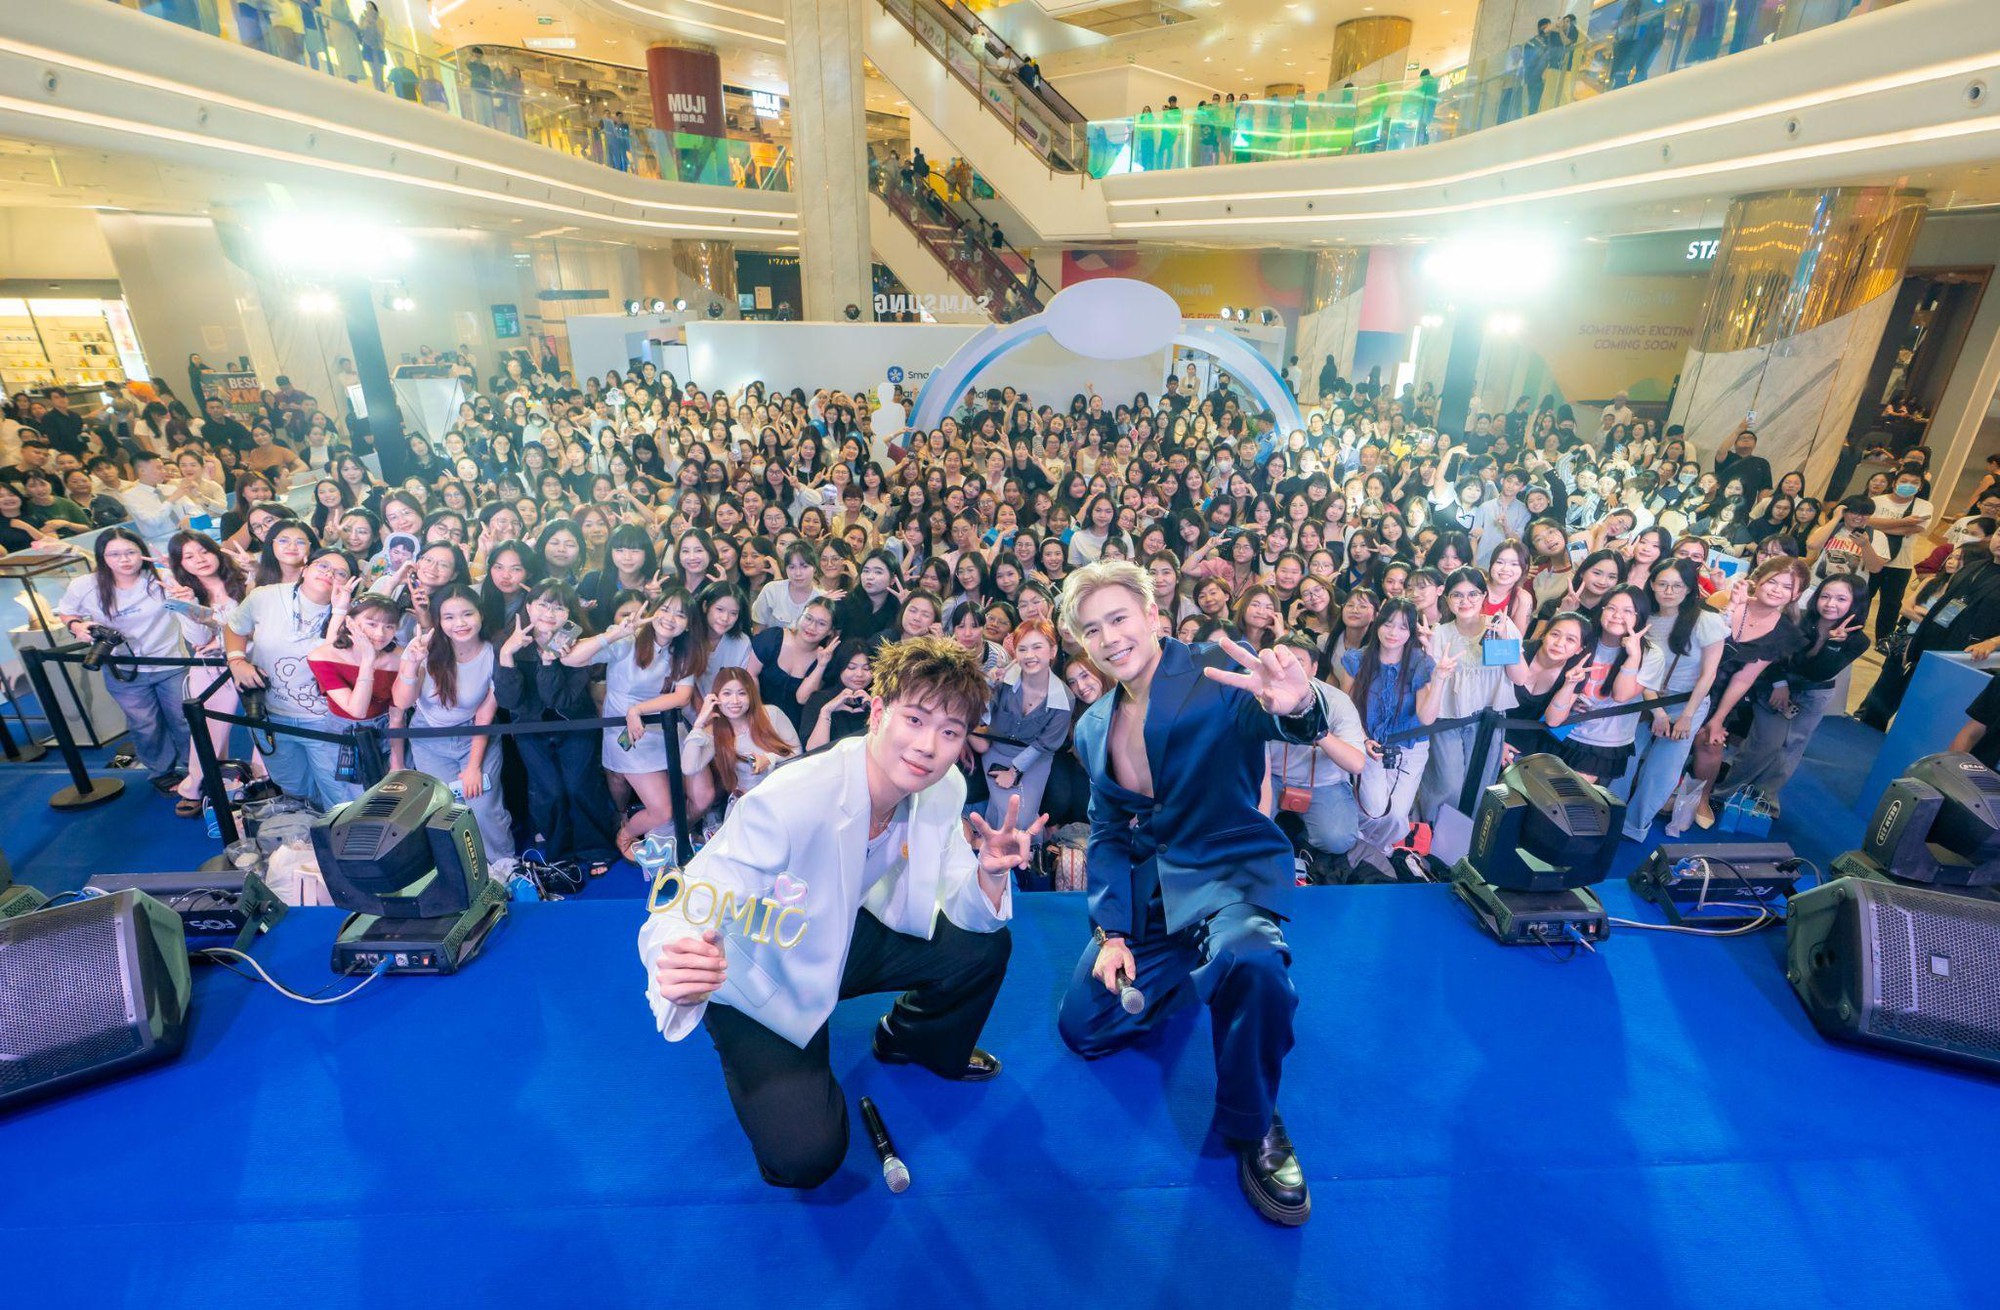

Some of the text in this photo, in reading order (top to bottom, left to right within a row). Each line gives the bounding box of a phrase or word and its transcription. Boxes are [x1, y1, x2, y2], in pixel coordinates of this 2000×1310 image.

[667, 93, 707, 114] MUJI
[1578, 324, 1646, 336] SOMETHING
[1594, 340, 1678, 351] COMING SOON
[1887, 806, 1898, 827] BEAM
[649, 868, 808, 949] DOMIC
